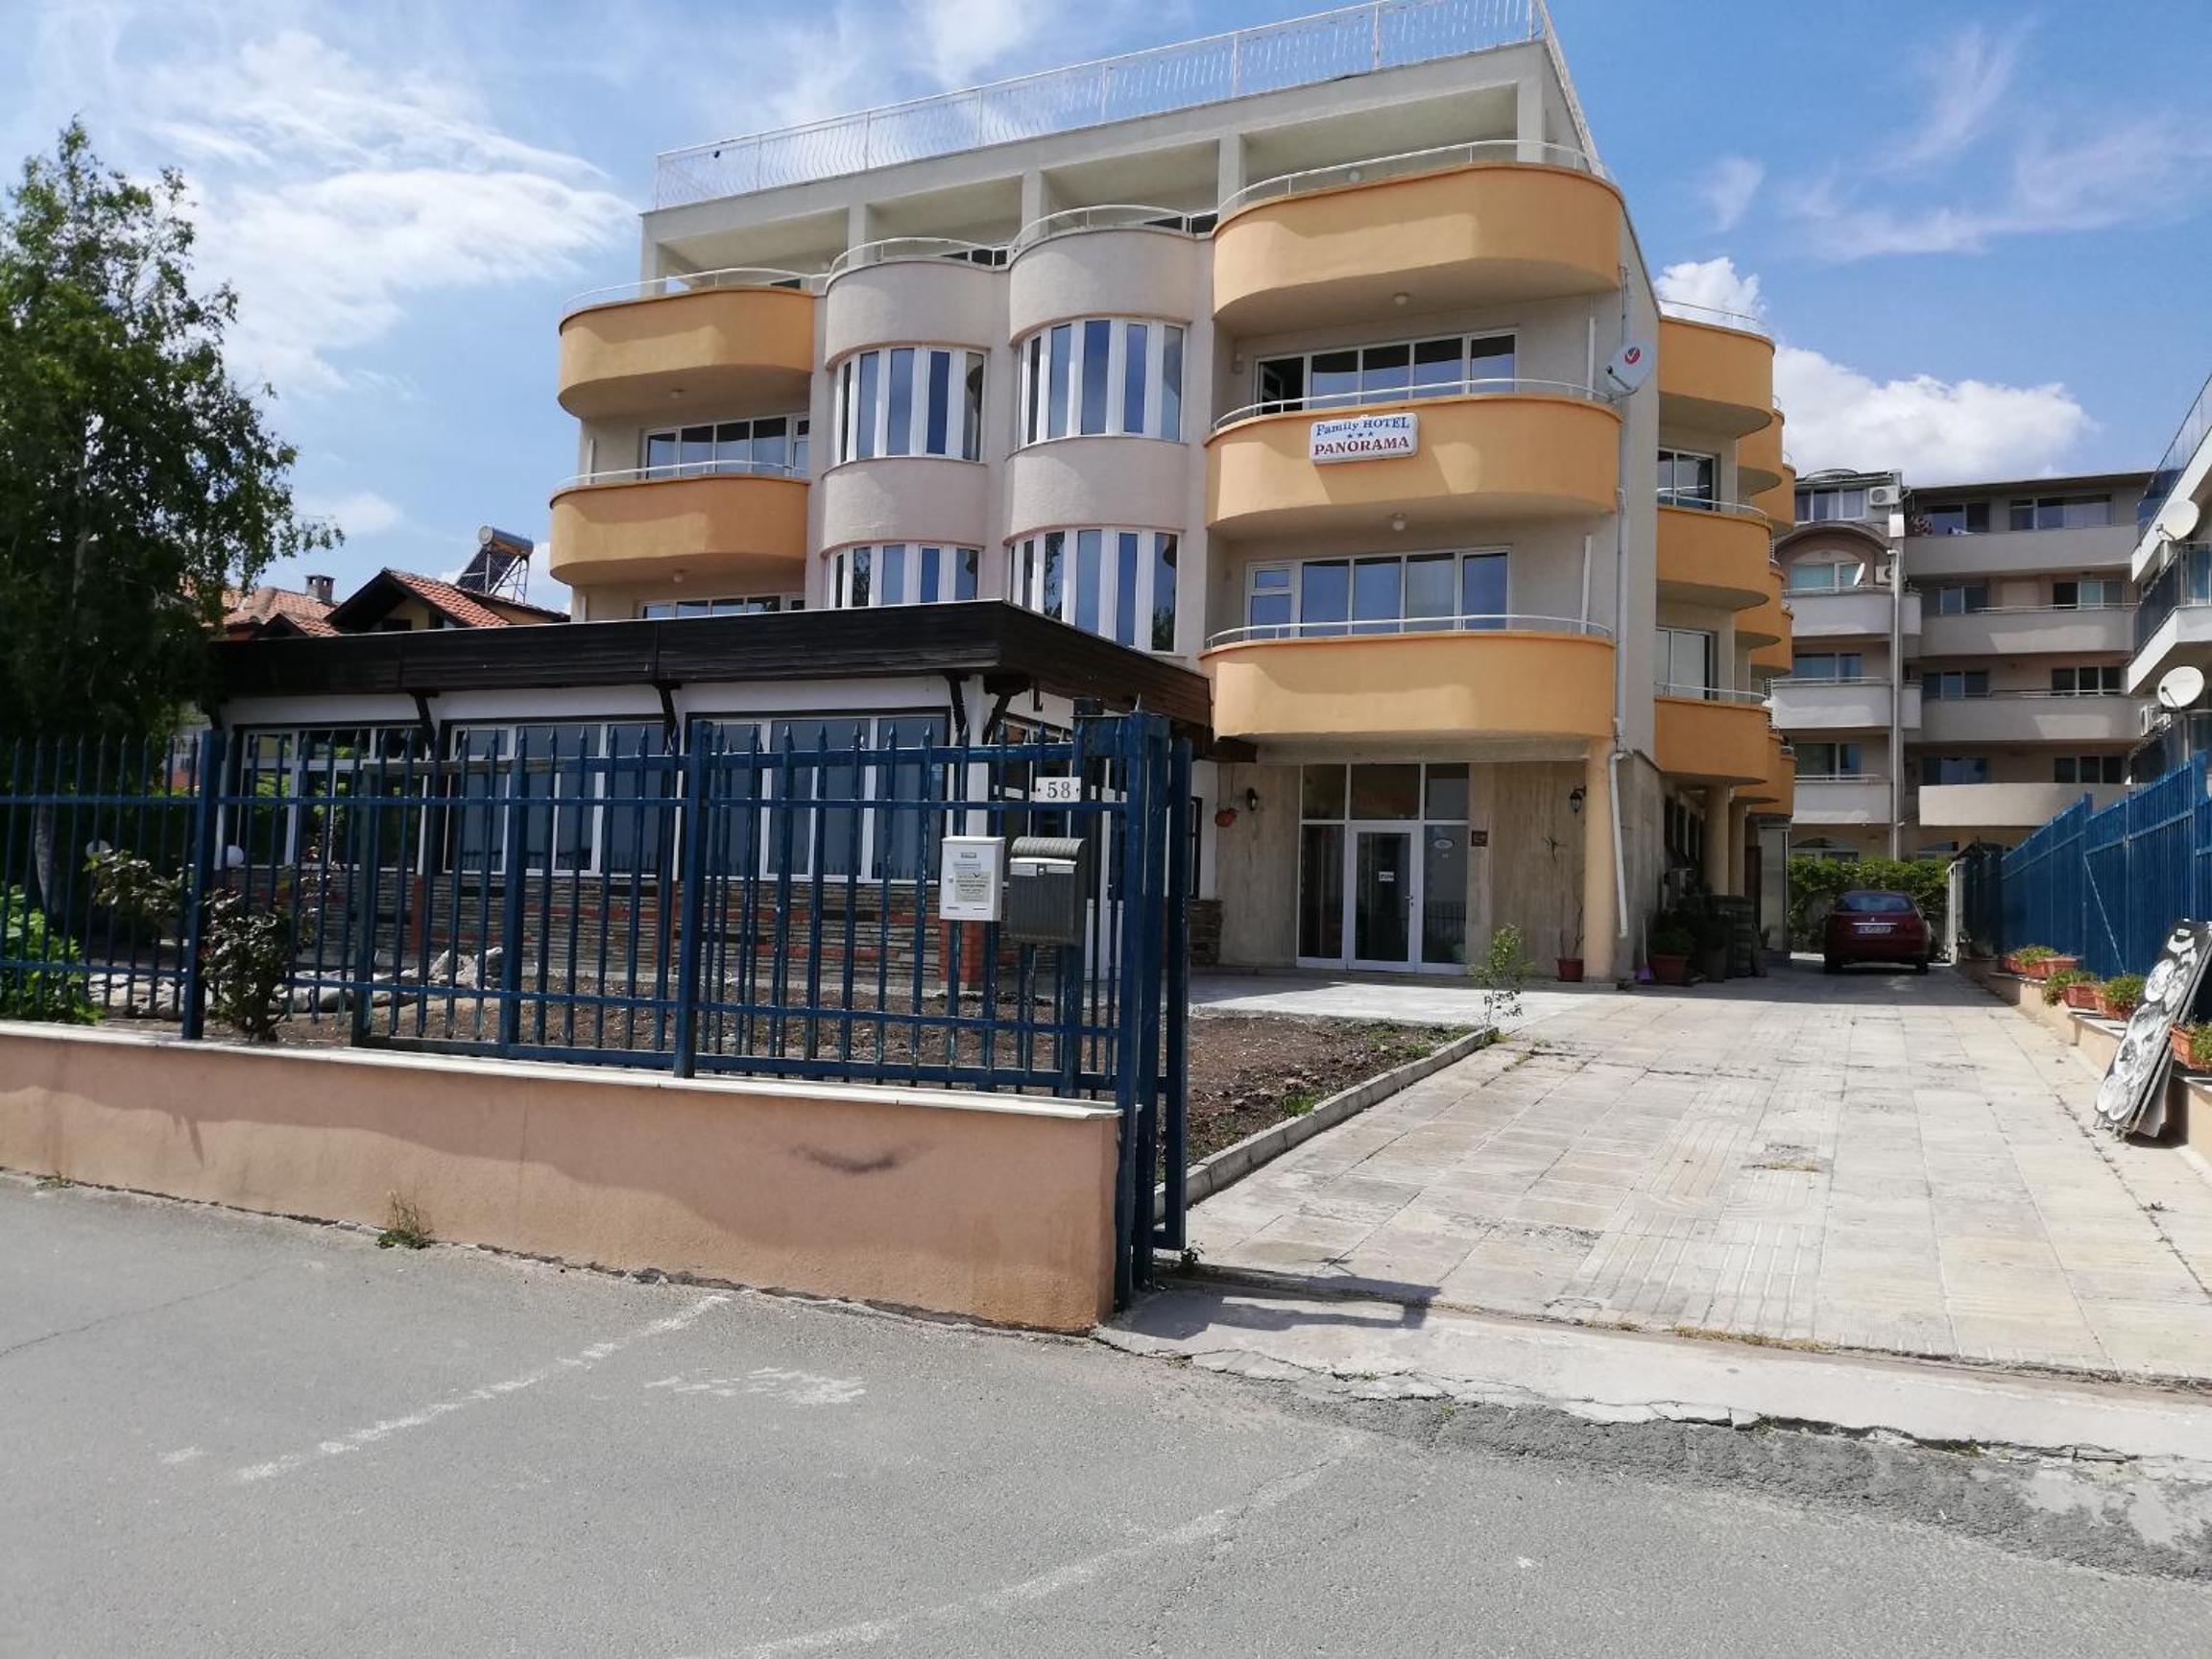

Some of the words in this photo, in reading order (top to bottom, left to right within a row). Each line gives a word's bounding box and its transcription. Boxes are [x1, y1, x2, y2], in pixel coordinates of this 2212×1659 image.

[1315, 421, 1358, 436] Family
[1363, 417, 1409, 429] HOTEL
[1314, 436, 1409, 455] PANORAMA
[1046, 781, 1070, 799] 58
